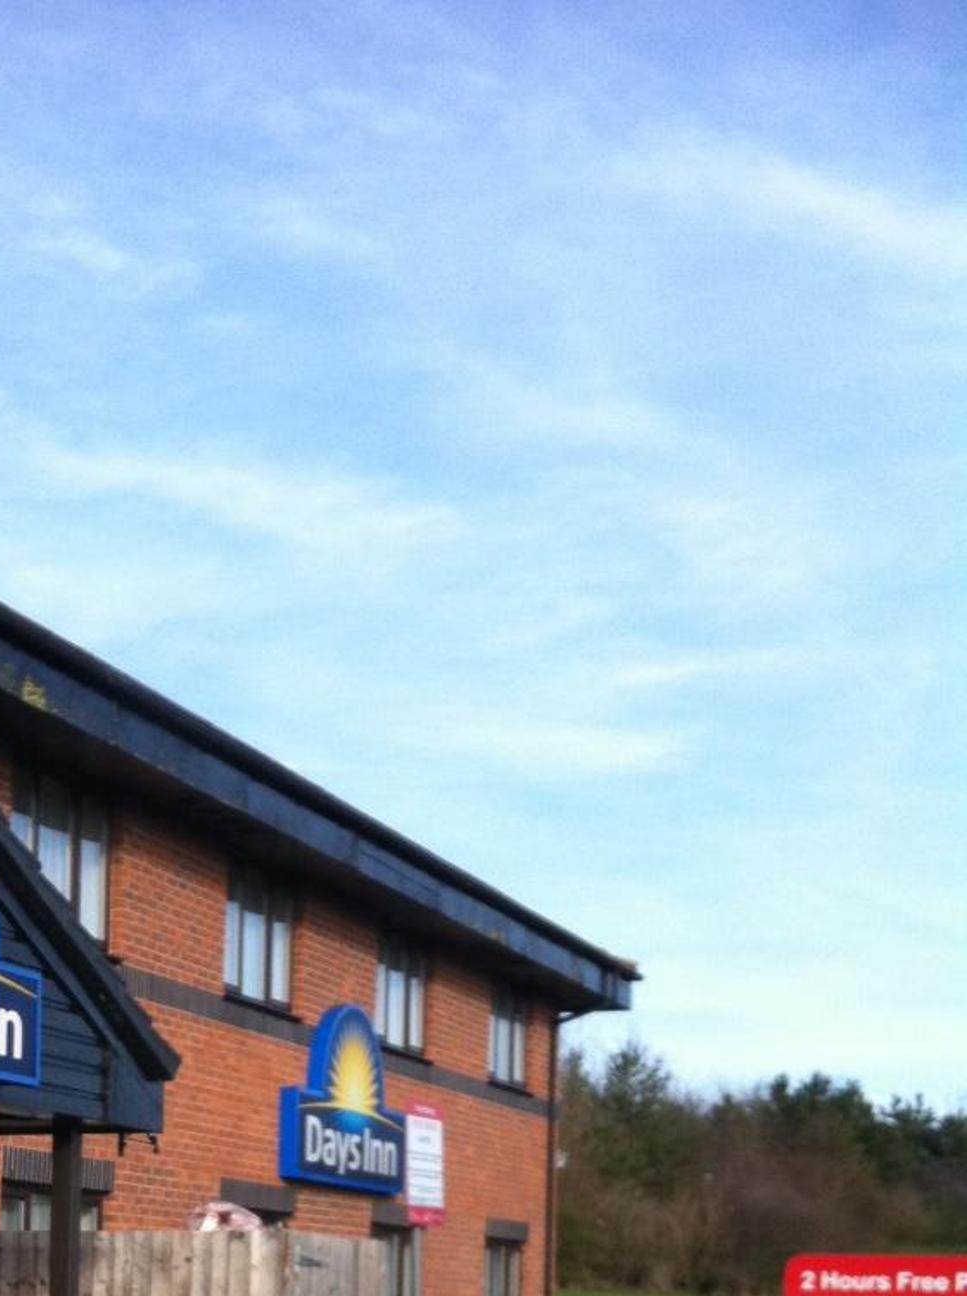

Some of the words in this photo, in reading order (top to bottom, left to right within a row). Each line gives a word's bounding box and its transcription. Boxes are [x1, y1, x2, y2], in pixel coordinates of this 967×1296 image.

[304, 1114, 361, 1175] Days
[363, 1128, 398, 1177] Inn
[800, 1269, 816, 1291] 2
[820, 1270, 892, 1292] Hours
[897, 1271, 950, 1293] Free
